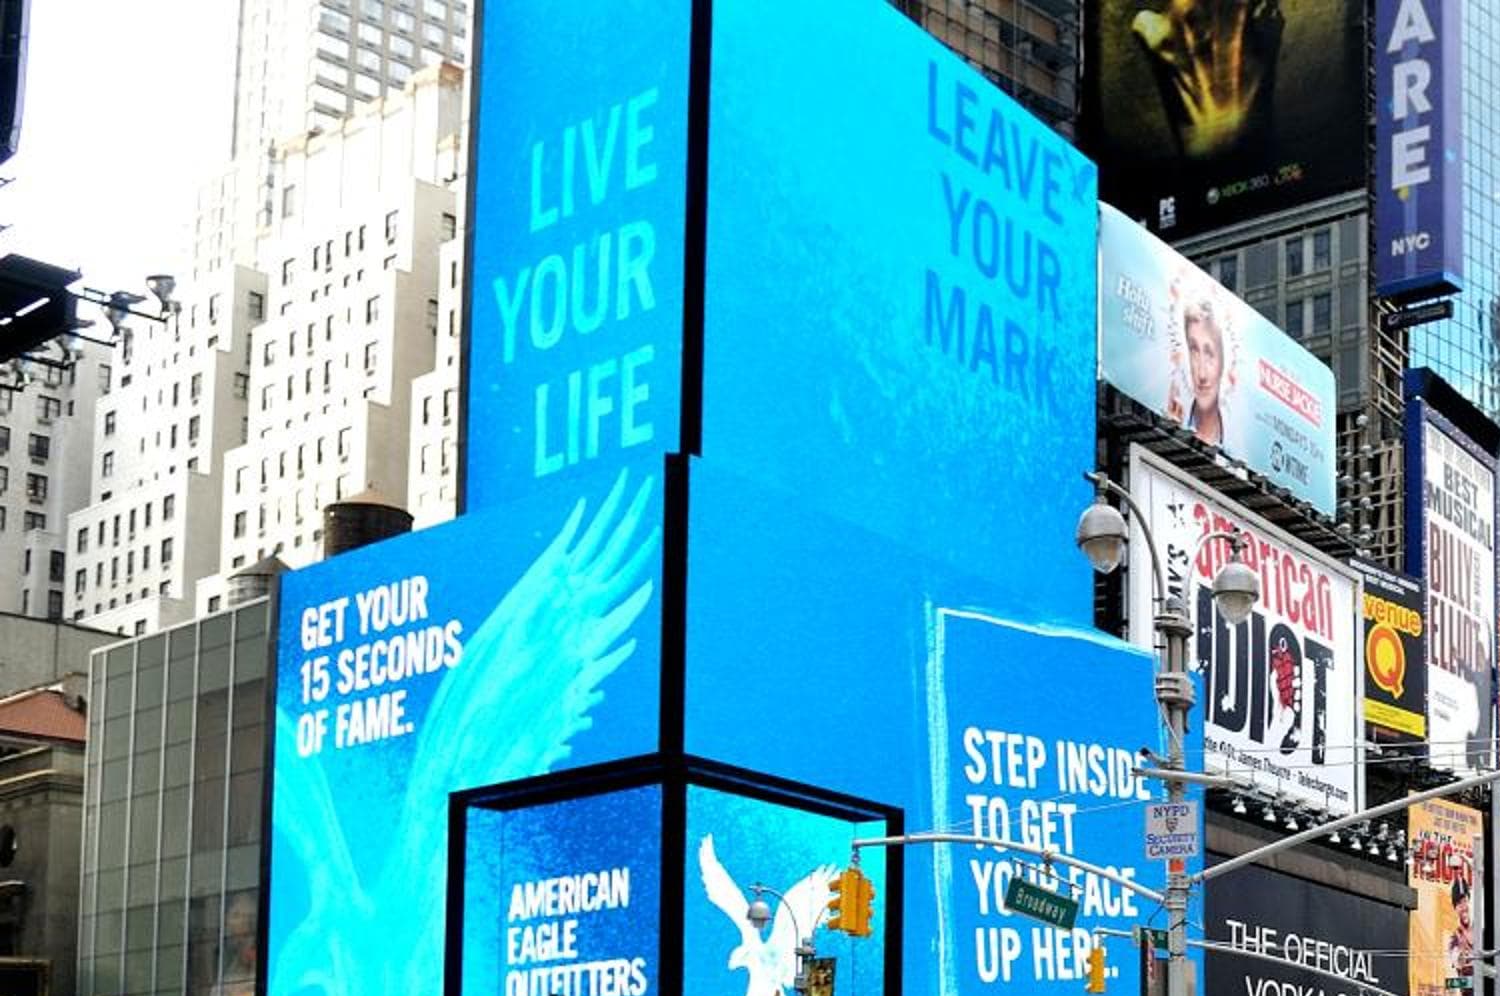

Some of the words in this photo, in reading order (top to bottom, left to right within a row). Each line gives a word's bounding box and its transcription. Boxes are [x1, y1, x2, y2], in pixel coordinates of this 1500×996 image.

[530, 87, 659, 232] LIVE
[927, 61, 1064, 226] LEAVE
[942, 172, 1061, 321] YOUR
[1391, 233, 1431, 257] NYC
[493, 220, 656, 364] YOUR
[925, 268, 1056, 408] MARK
[534, 344, 655, 479] LIFE
[1424, 480, 1492, 552] MUSICAL
[1443, 462, 1478, 510] BEST
[1430, 521, 1474, 612] BILLY
[301, 599, 348, 652] GET
[355, 575, 430, 634] YOUR
[1363, 592, 1424, 637] venue
[299, 656, 330, 705] 15
[336, 620, 464, 696] SECONDS
[1366, 622, 1406, 700] Q
[296, 710, 328, 759] OF
[335, 691, 414, 750] FAME.
[962, 727, 1046, 790] STEP
[1057, 740, 1152, 802] INSIDE
[965, 794, 1013, 855] TO
[1020, 800, 1077, 856] GET
[1153, 805, 1189, 819] NYPD
[508, 867, 629, 922] AMERICAN
[1016, 887, 1067, 925] Broadway
[1069, 863, 1138, 918] FACE
[508, 920, 578, 965] EAGLE
[975, 928, 1022, 984] UP
[1225, 919, 1277, 957] THE
[1283, 933, 1379, 983] OFFICIAL
